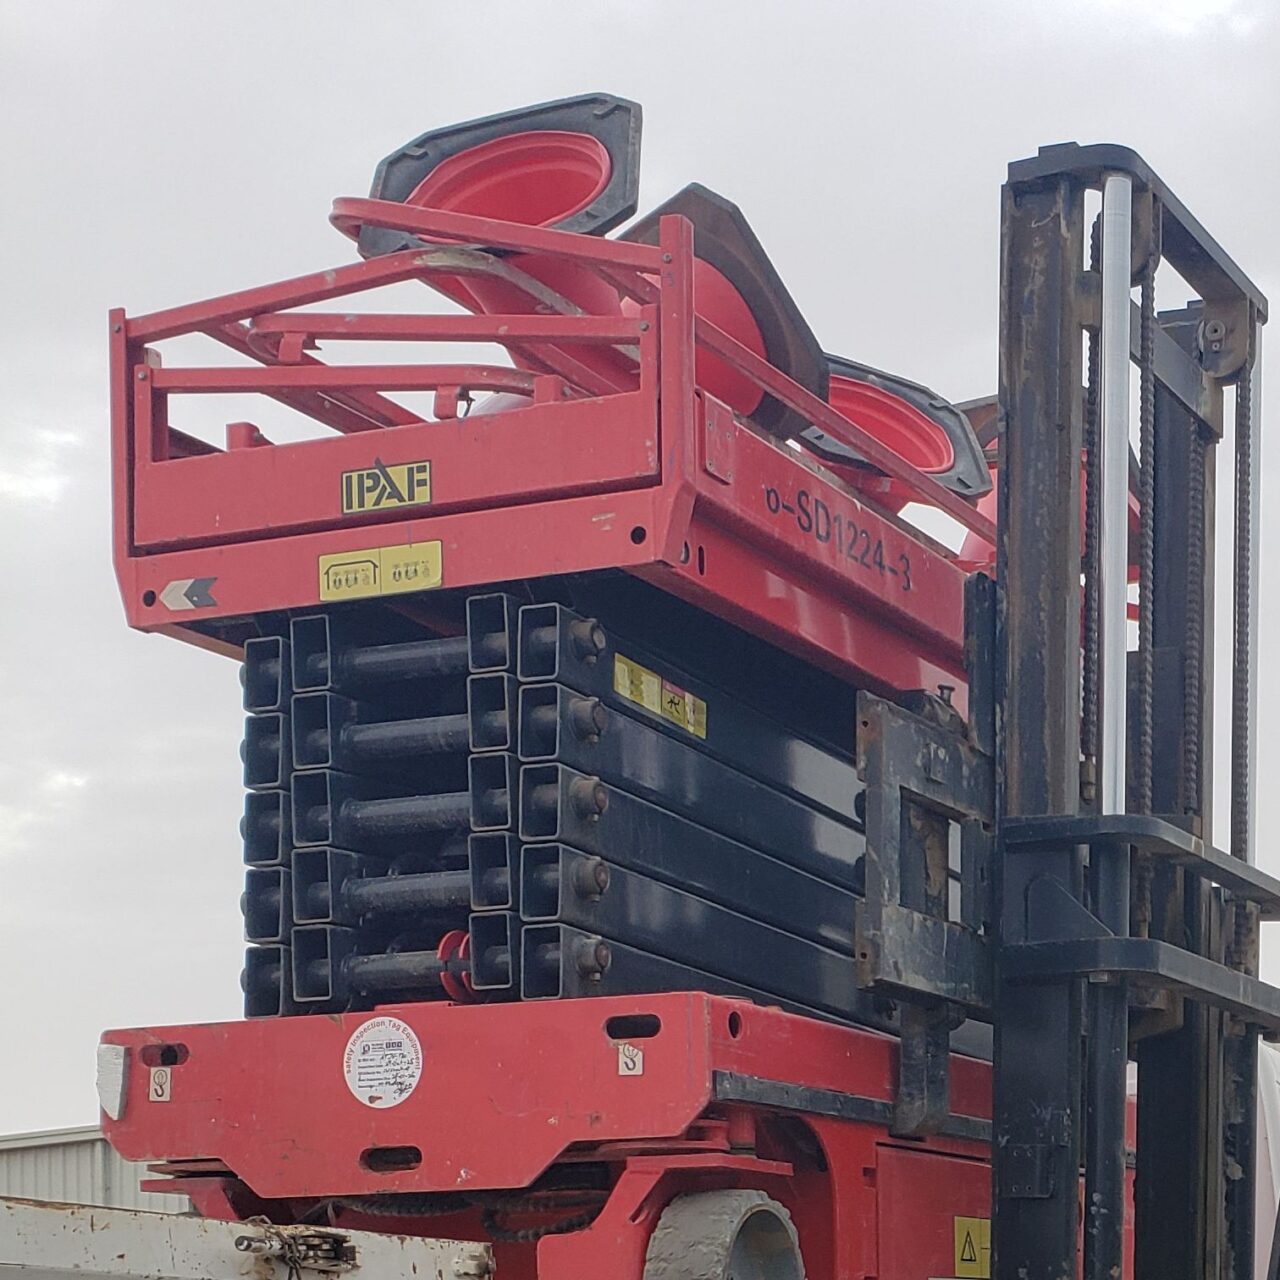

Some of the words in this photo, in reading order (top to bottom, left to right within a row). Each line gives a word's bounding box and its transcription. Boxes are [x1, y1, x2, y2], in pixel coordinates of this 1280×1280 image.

[345, 457, 429, 511] IPAF
[351, 1020, 386, 1047] Inspection
[388, 1020, 401, 1032] Tag
[401, 1026, 421, 1070] Equipment
